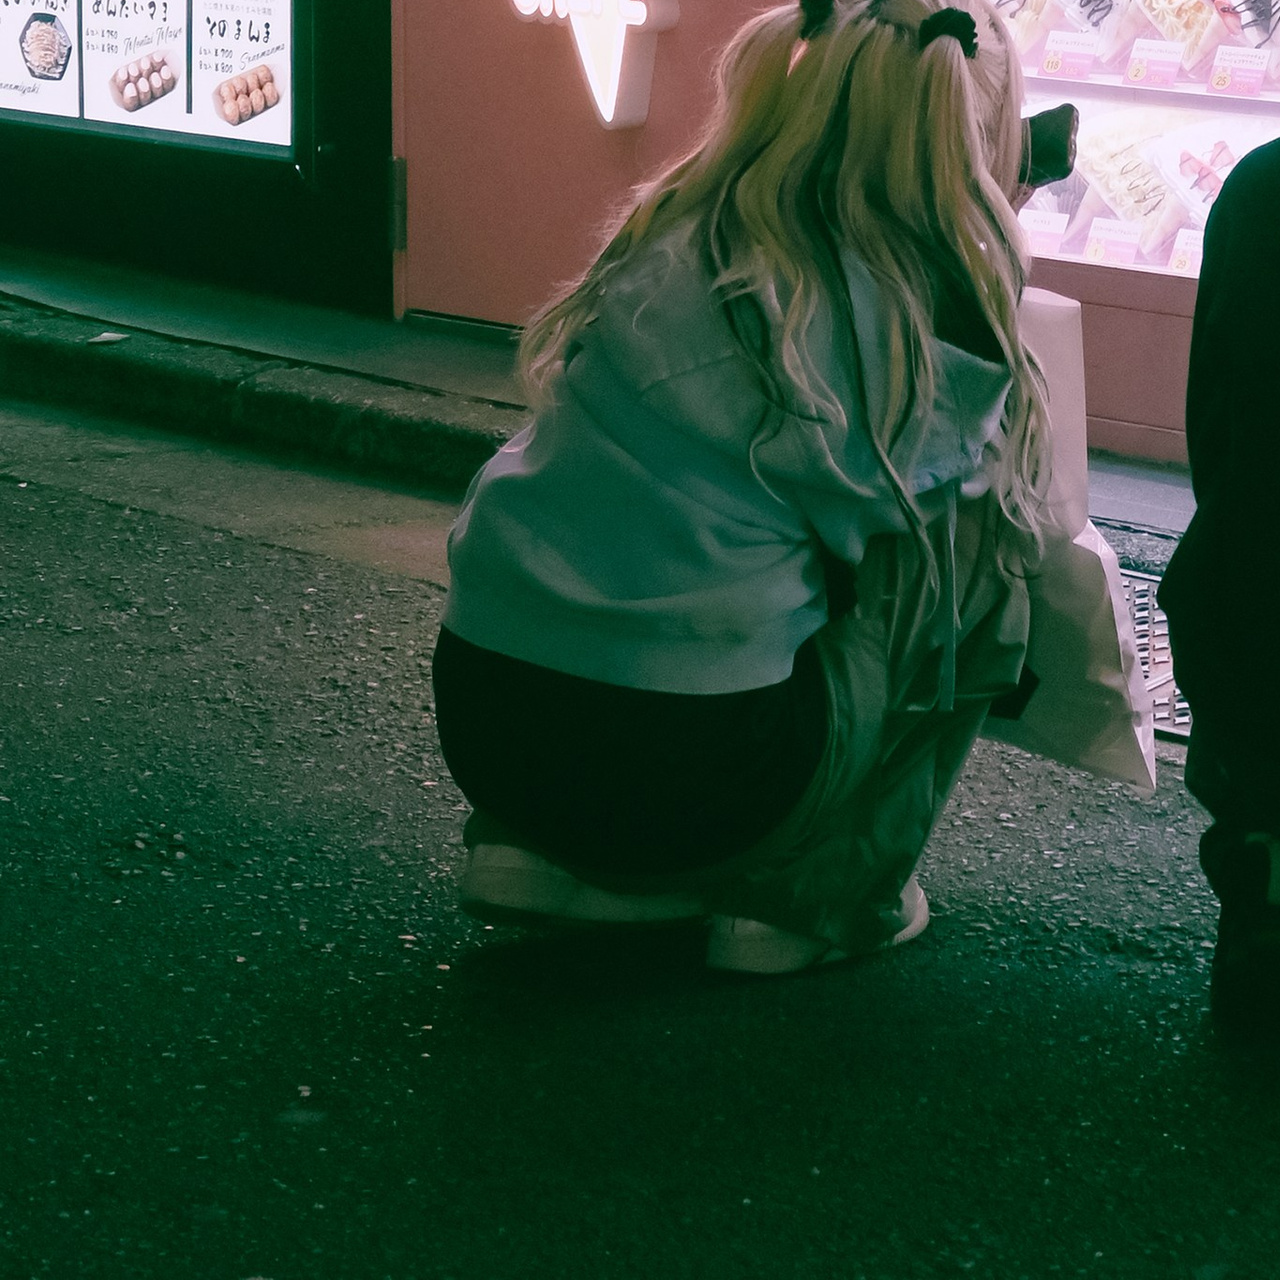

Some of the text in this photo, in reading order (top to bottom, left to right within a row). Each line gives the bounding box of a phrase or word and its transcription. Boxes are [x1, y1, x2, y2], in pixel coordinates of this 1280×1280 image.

[206, 16, 271, 44] そのまんま
[1133, 68, 1141, 78] 2
[1215, 76, 1227, 87] 25
